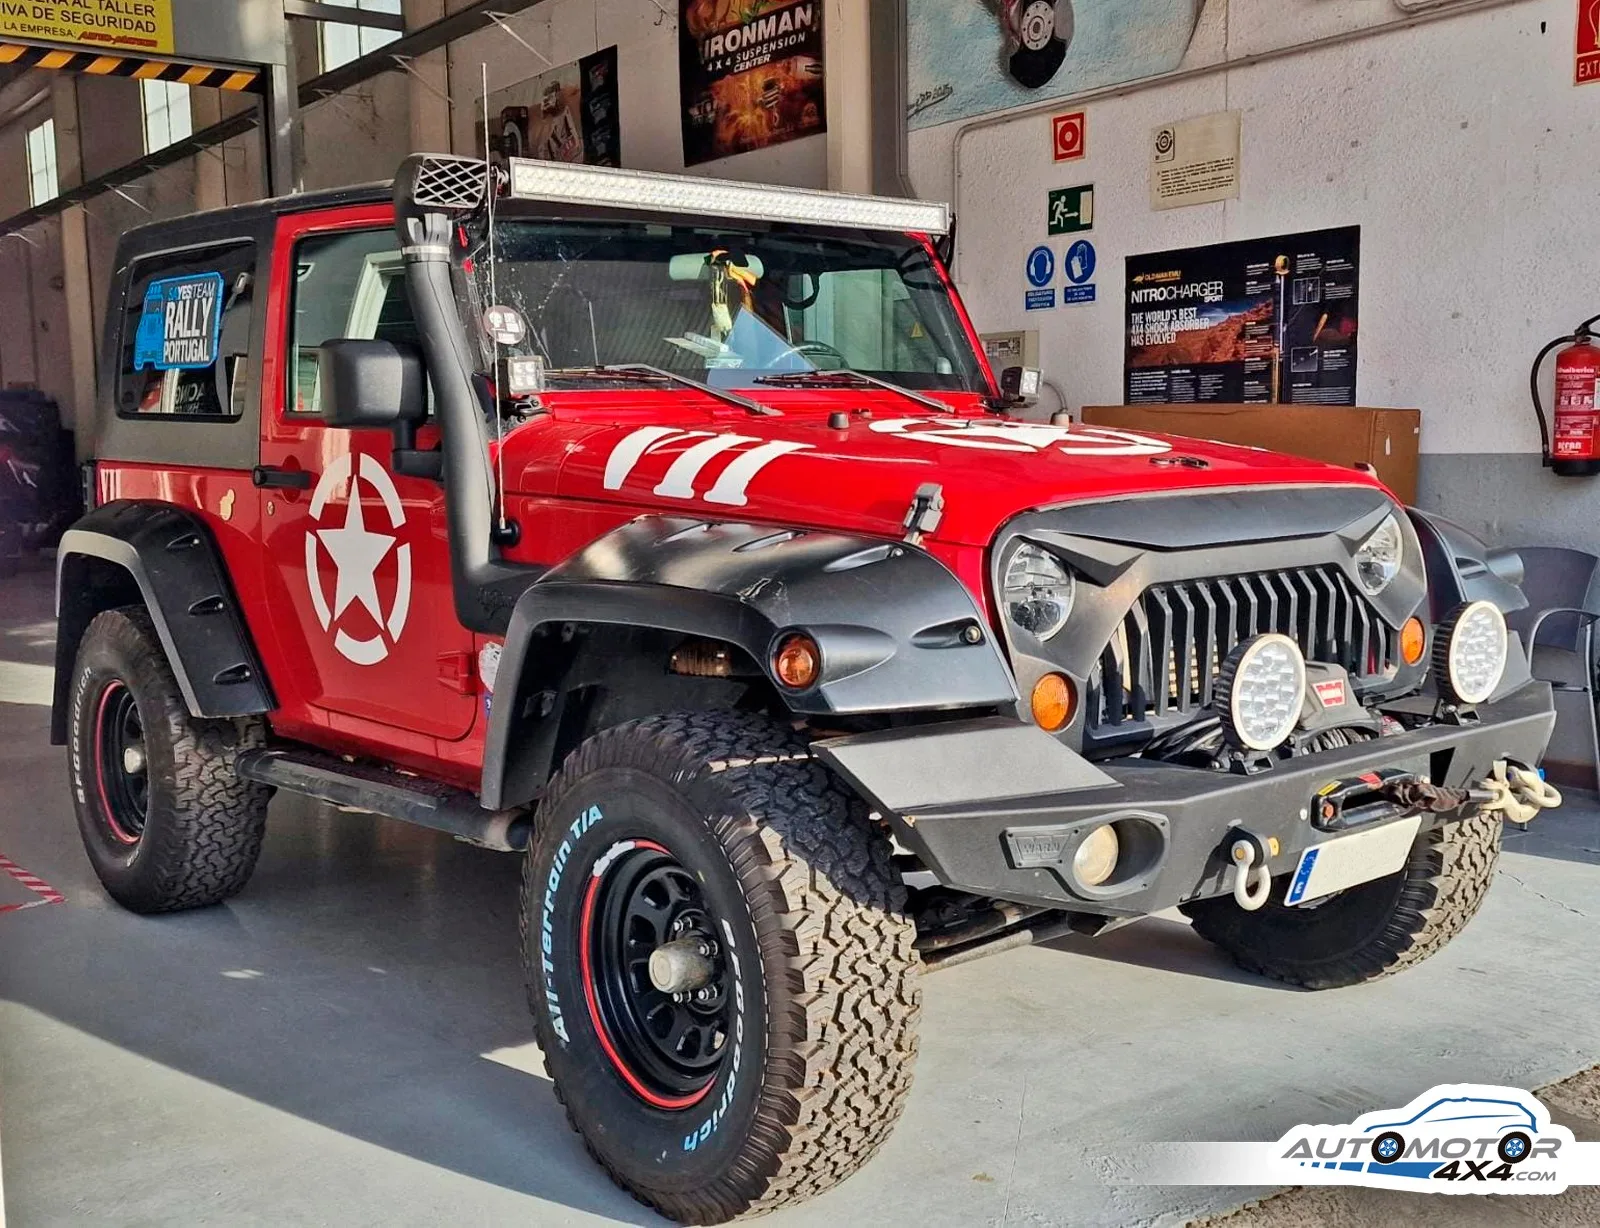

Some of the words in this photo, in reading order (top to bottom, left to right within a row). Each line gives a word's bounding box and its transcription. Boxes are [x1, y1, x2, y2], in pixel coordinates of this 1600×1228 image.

[32, 6, 55, 20] DE
[60, 10, 156, 33] SEGURIDAD
[98, 0, 156, 17] TALLER
[4, 21, 18, 31] LA
[20, 23, 77, 38] EMPRESA:
[704, 4, 812, 57] IRONMAN
[736, 32, 806, 62] SUSPENSION
[733, 53, 771, 73] CENTER
[1131, 280, 1224, 304] NITROCHARGER
[165, 298, 213, 338] RALLY
[1131, 313, 1144, 324] THE
[1145, 309, 1177, 322] WORLD'S
[1179, 307, 1197, 320] BEST
[1145, 321, 1169, 334] SHOCK
[1170, 317, 1210, 332] ABSORBER
[1131, 334, 1144, 346] HAS
[1145, 332, 1176, 345] EVOLVED
[163, 338, 210, 363] PORTUGAL
